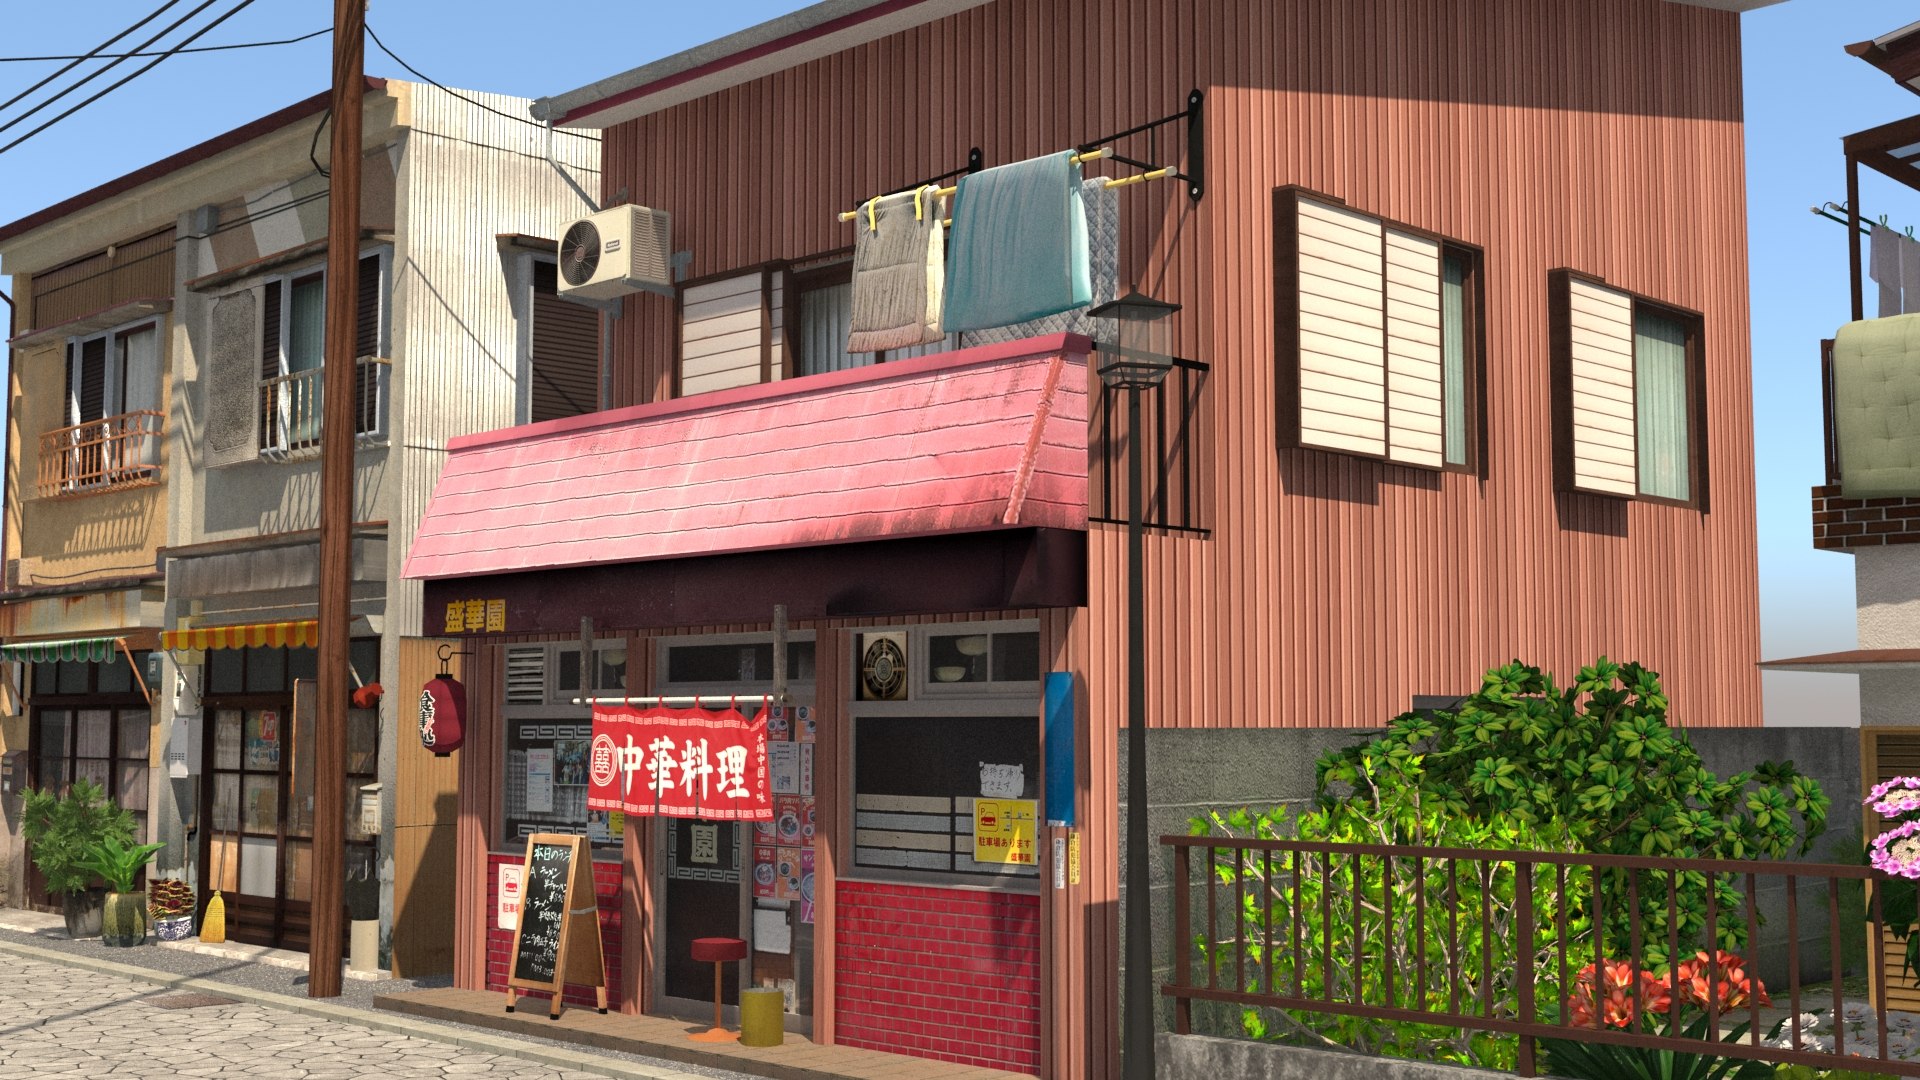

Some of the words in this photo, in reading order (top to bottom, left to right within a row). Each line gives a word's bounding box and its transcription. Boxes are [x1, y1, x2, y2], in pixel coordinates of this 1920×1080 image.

[444, 598, 506, 633] 盛華園
[617, 734, 751, 801] 中華料理
[756, 733, 766, 804] 本場中国の味
[690, 823, 719, 865] 園
[978, 836, 1032, 850] 駐車場あります
[1011, 852, 1031, 863] 盛華園
[529, 866, 537, 879] A
